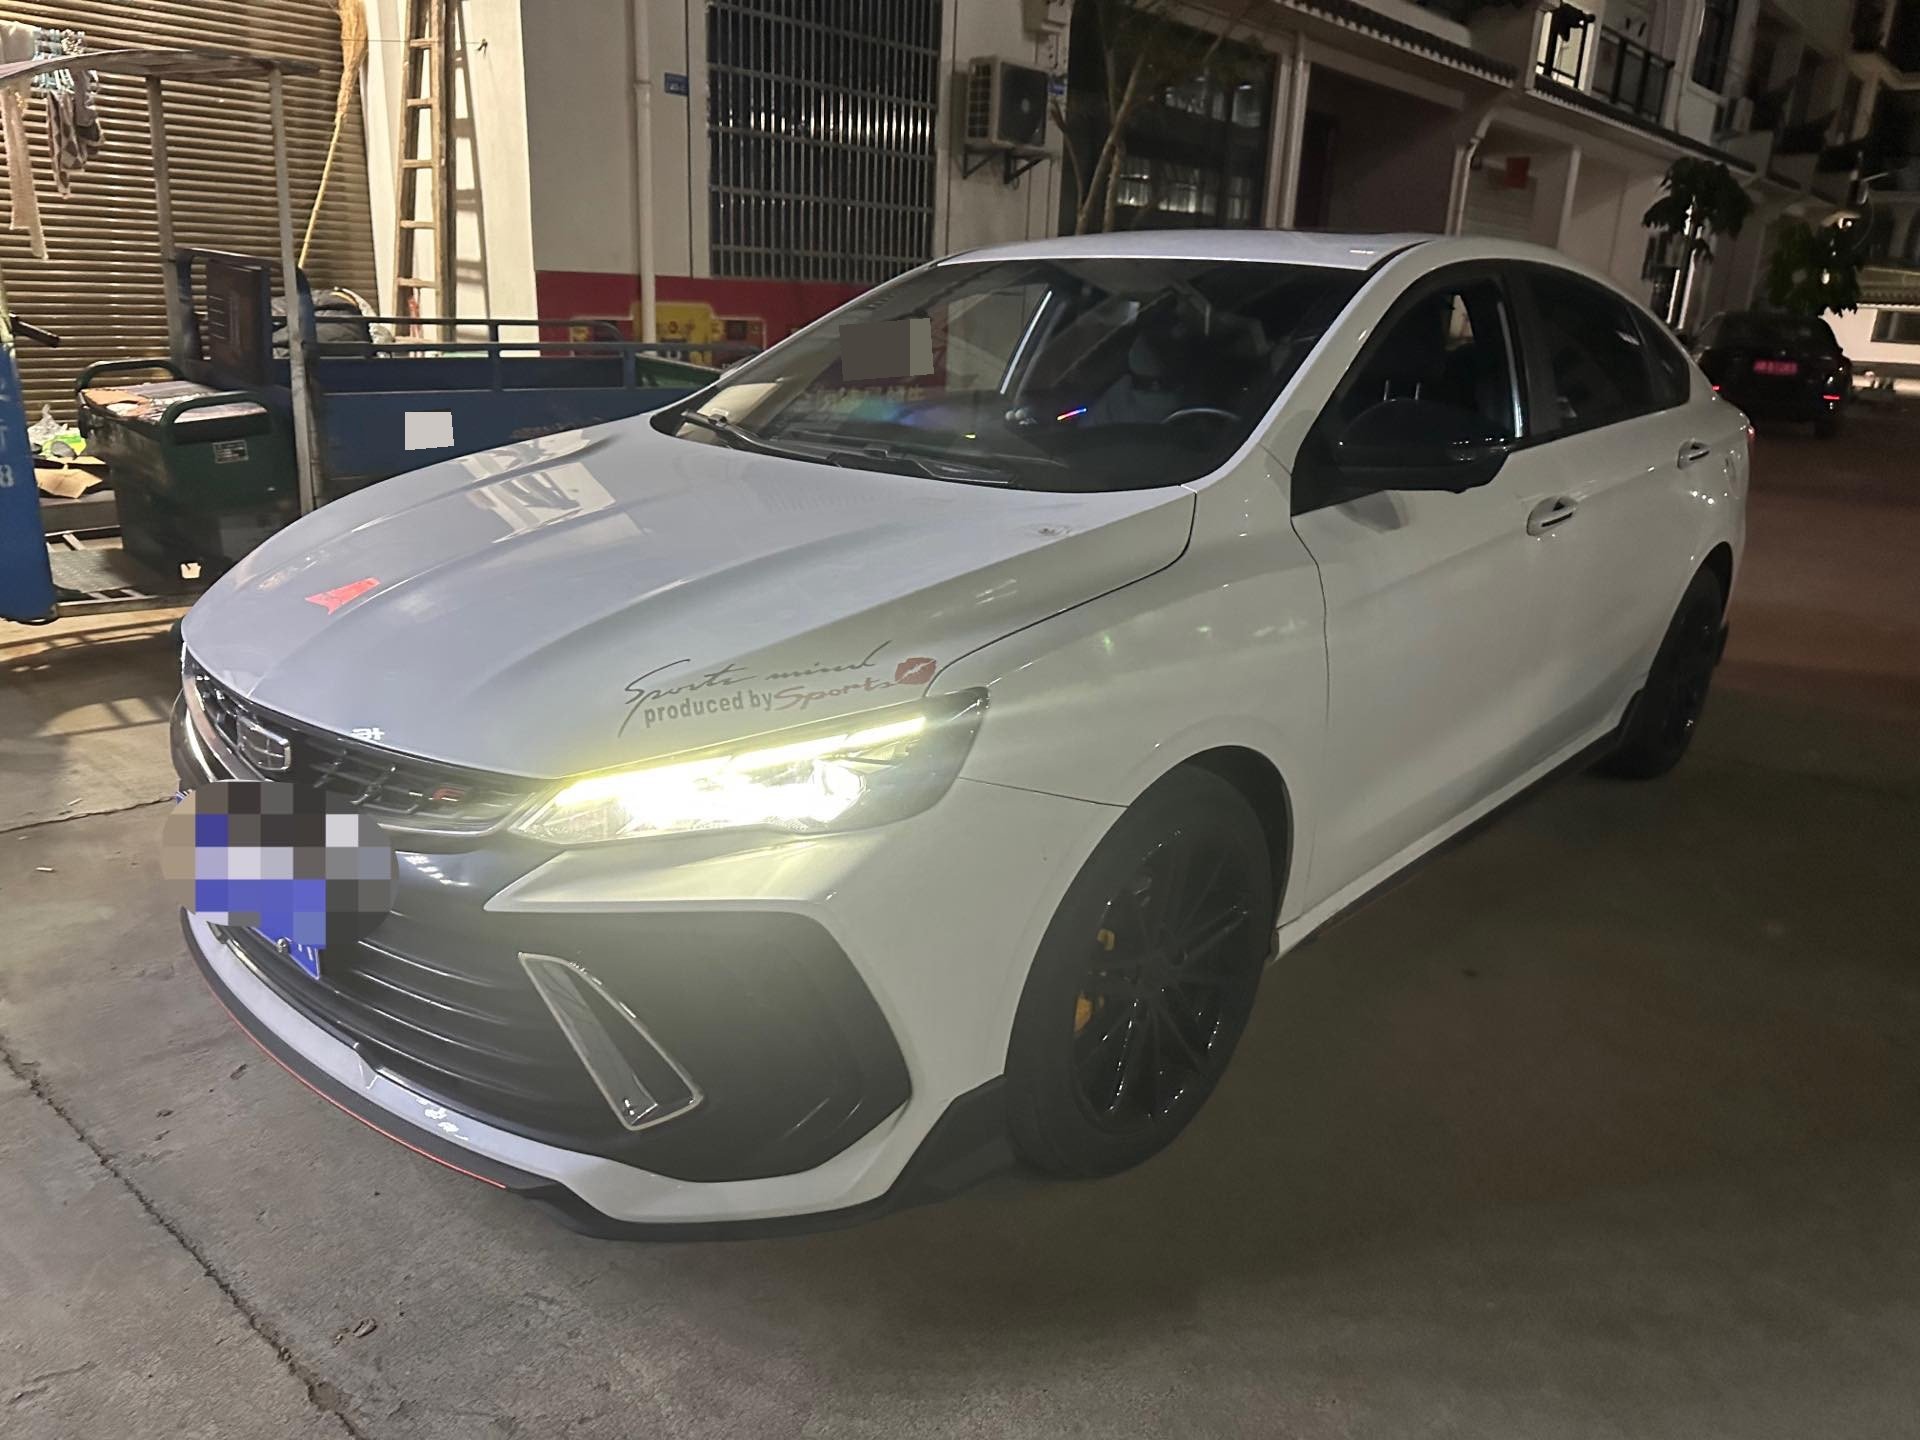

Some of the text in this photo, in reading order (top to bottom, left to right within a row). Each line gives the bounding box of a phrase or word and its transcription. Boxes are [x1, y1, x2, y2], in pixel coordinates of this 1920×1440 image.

[643, 677, 899, 729] produced by Sports
